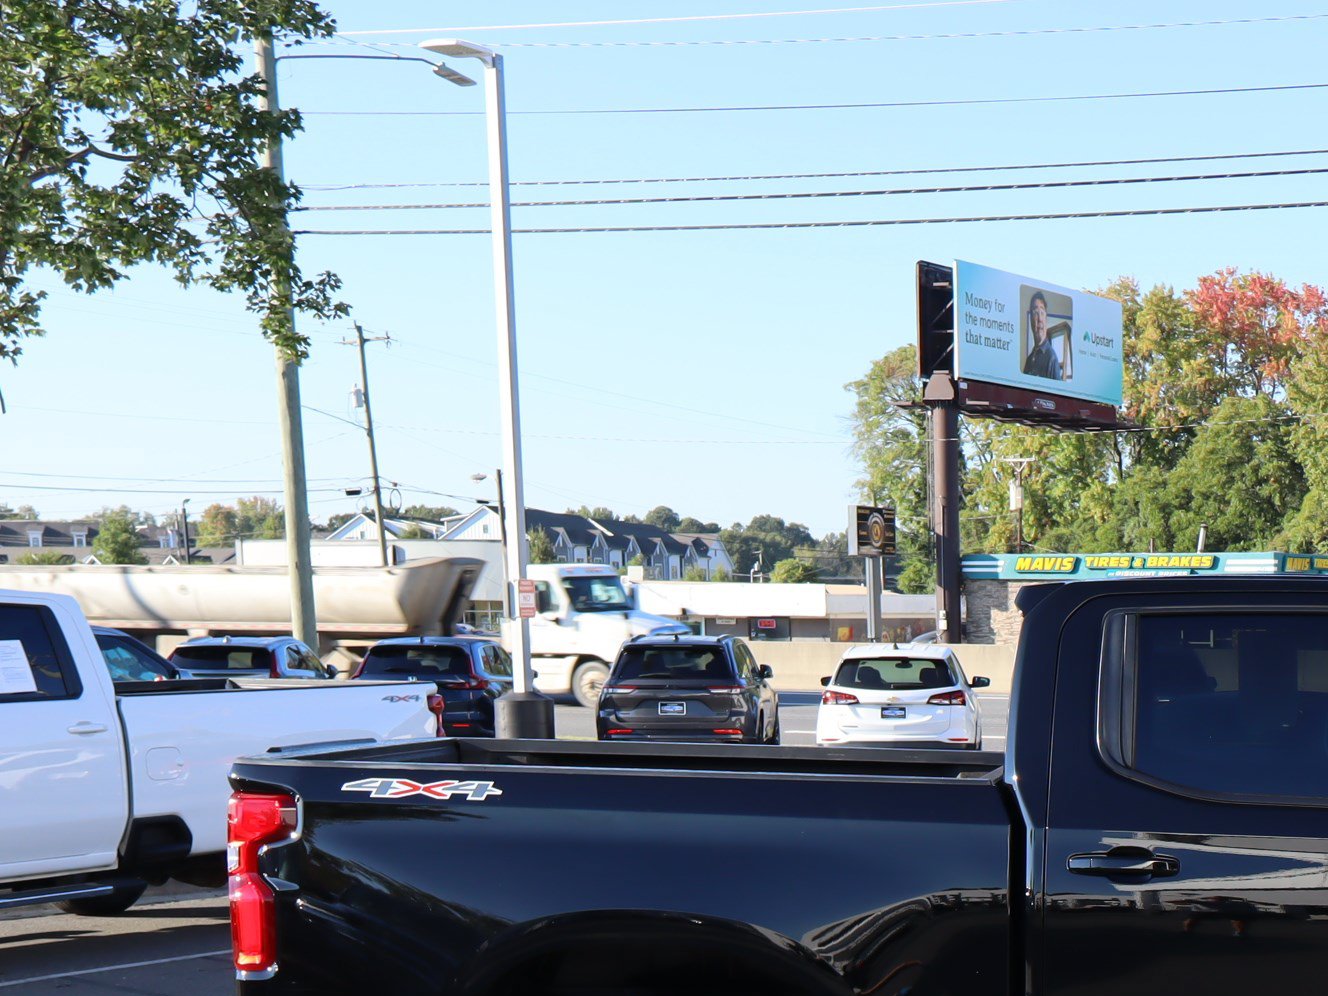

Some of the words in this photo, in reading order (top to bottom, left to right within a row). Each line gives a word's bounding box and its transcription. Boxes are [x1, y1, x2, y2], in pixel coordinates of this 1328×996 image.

[965, 291, 992, 313] Money
[994, 299, 1006, 313] for
[965, 311, 978, 326] the
[979, 316, 1015, 334] moments
[965, 329, 983, 346] that
[1091, 331, 1114, 349] Upstart
[1015, 556, 1076, 572] MAVIS
[1084, 556, 1131, 568] TIRES
[1132, 557, 1145, 567] &
[1147, 555, 1213, 567] BRAKES
[1285, 557, 1311, 572] MAVIS
[341, 777, 503, 801] 4X4
